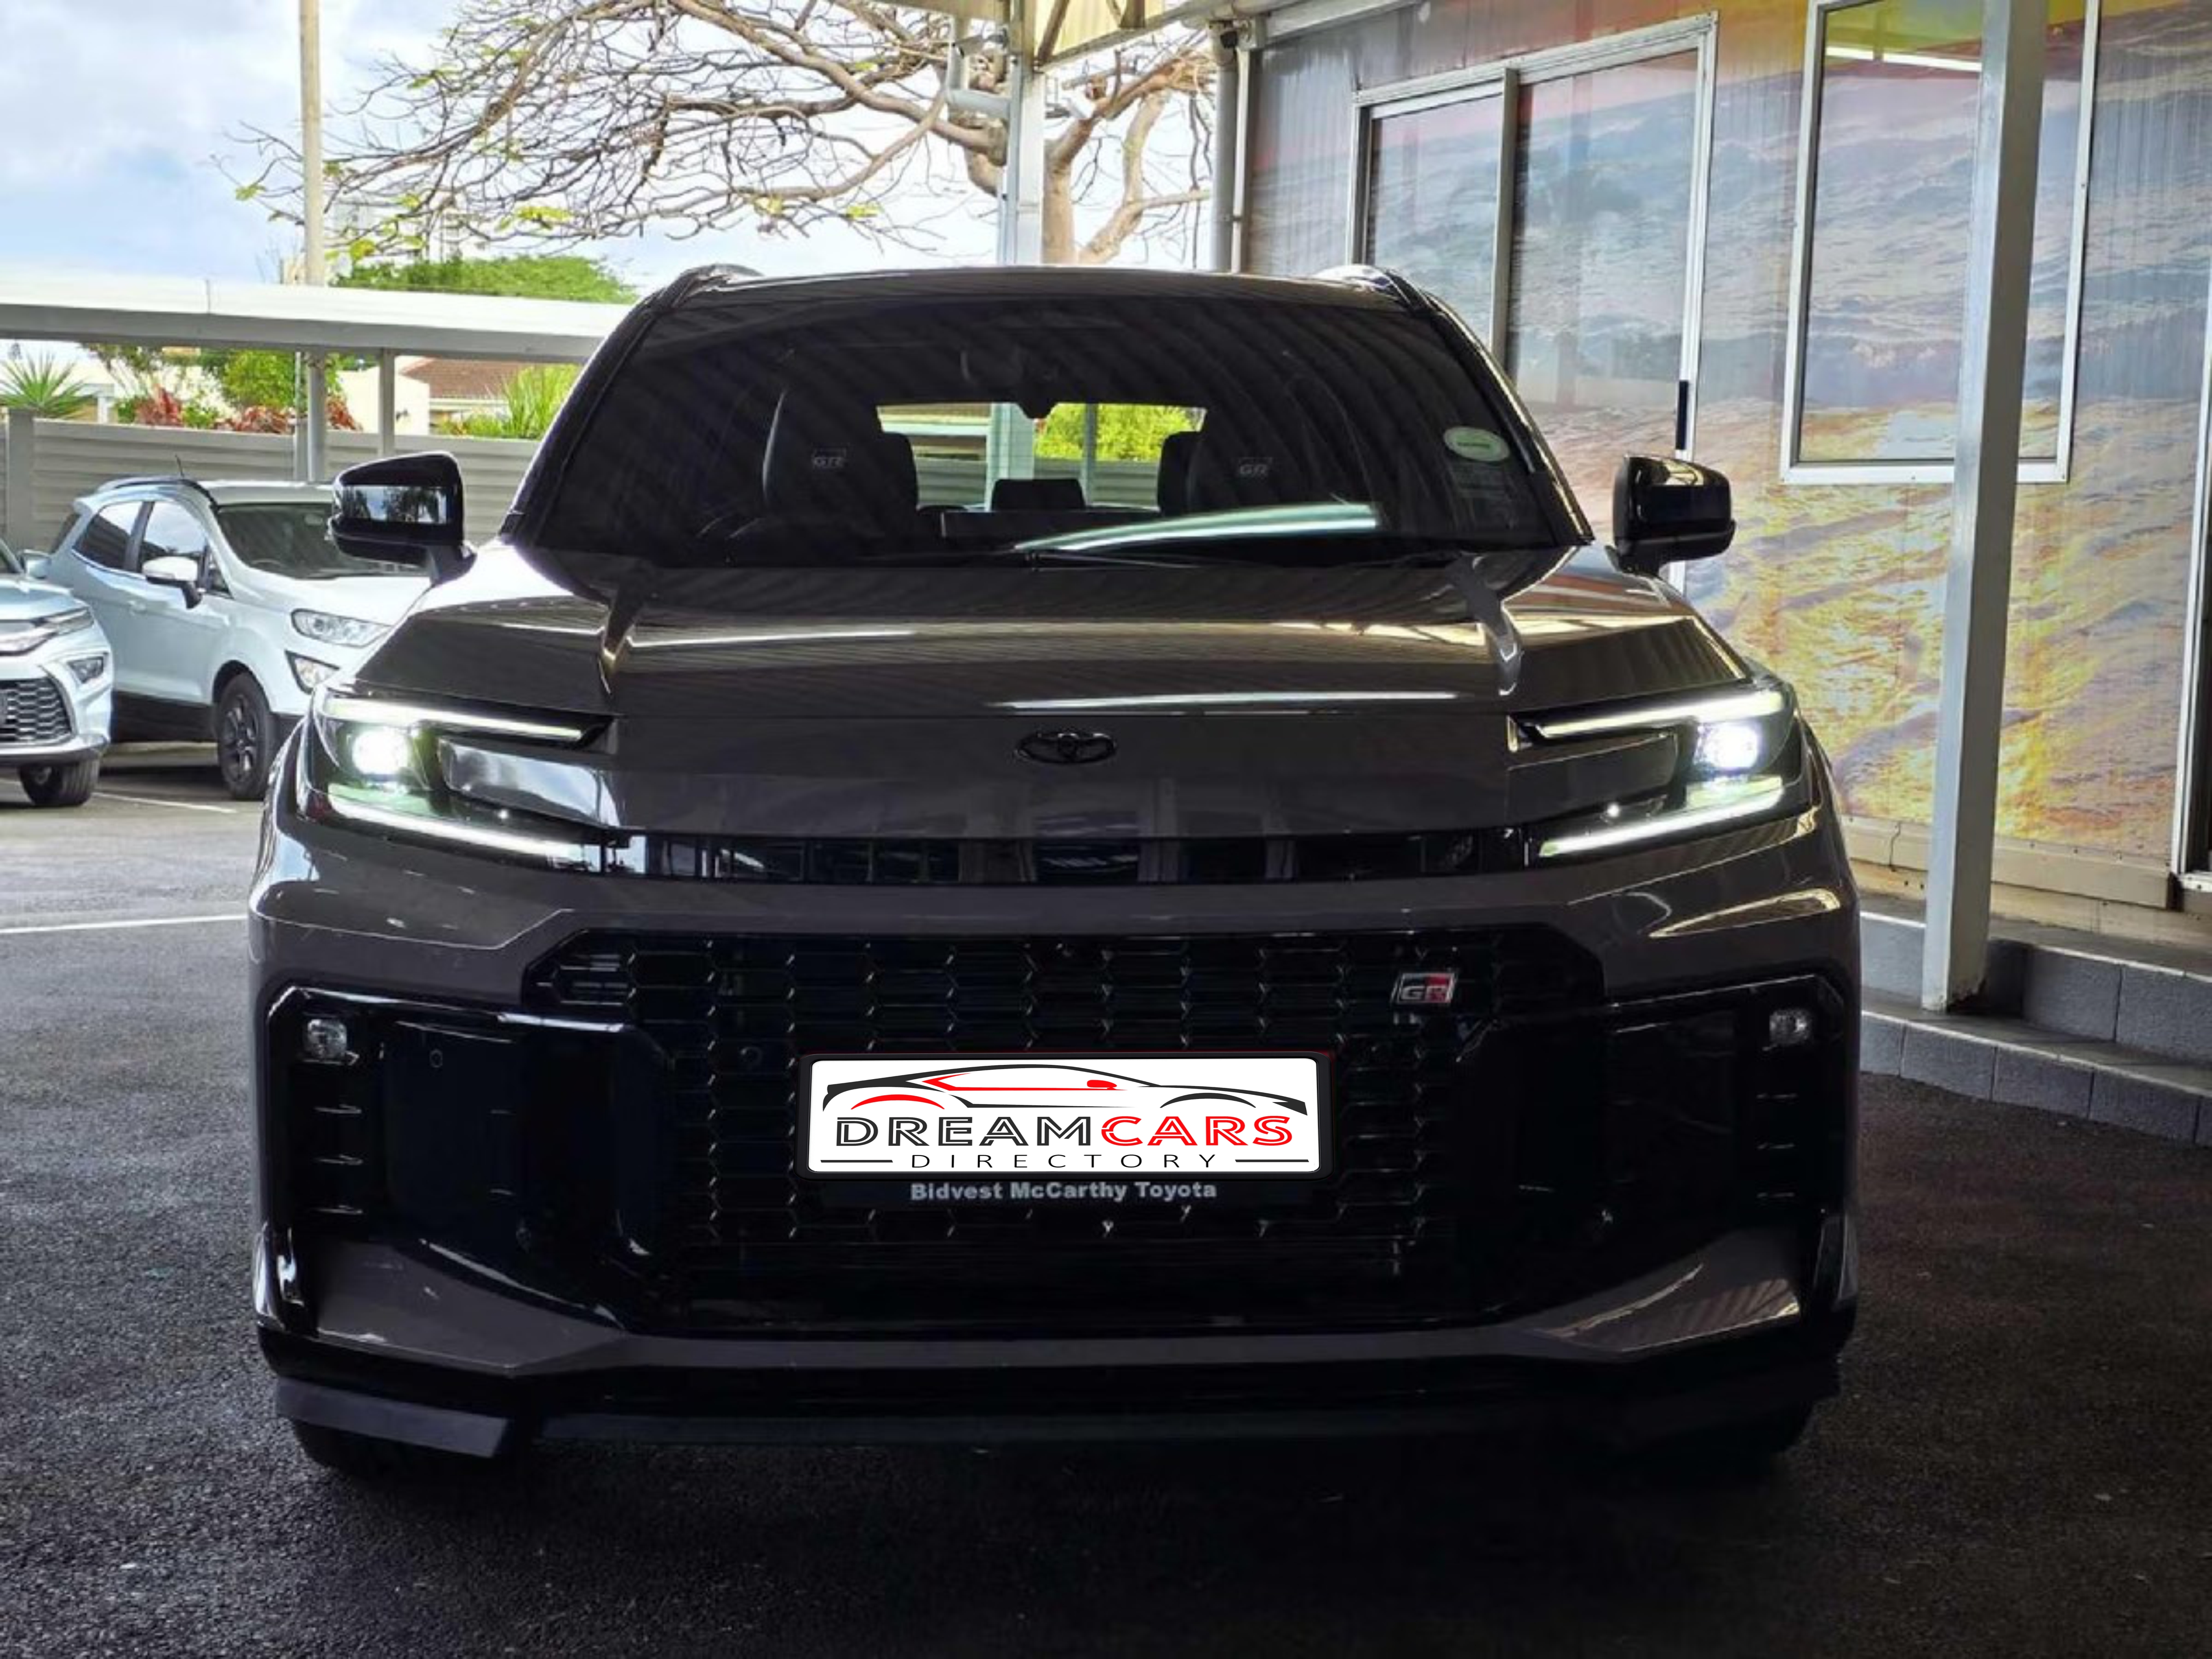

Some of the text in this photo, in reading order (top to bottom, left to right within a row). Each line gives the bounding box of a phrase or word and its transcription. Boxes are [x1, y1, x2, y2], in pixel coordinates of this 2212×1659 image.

[1401, 985, 1450, 1000] GR
[911, 1181, 1217, 1202] Bidvest McCarthy Toyota
